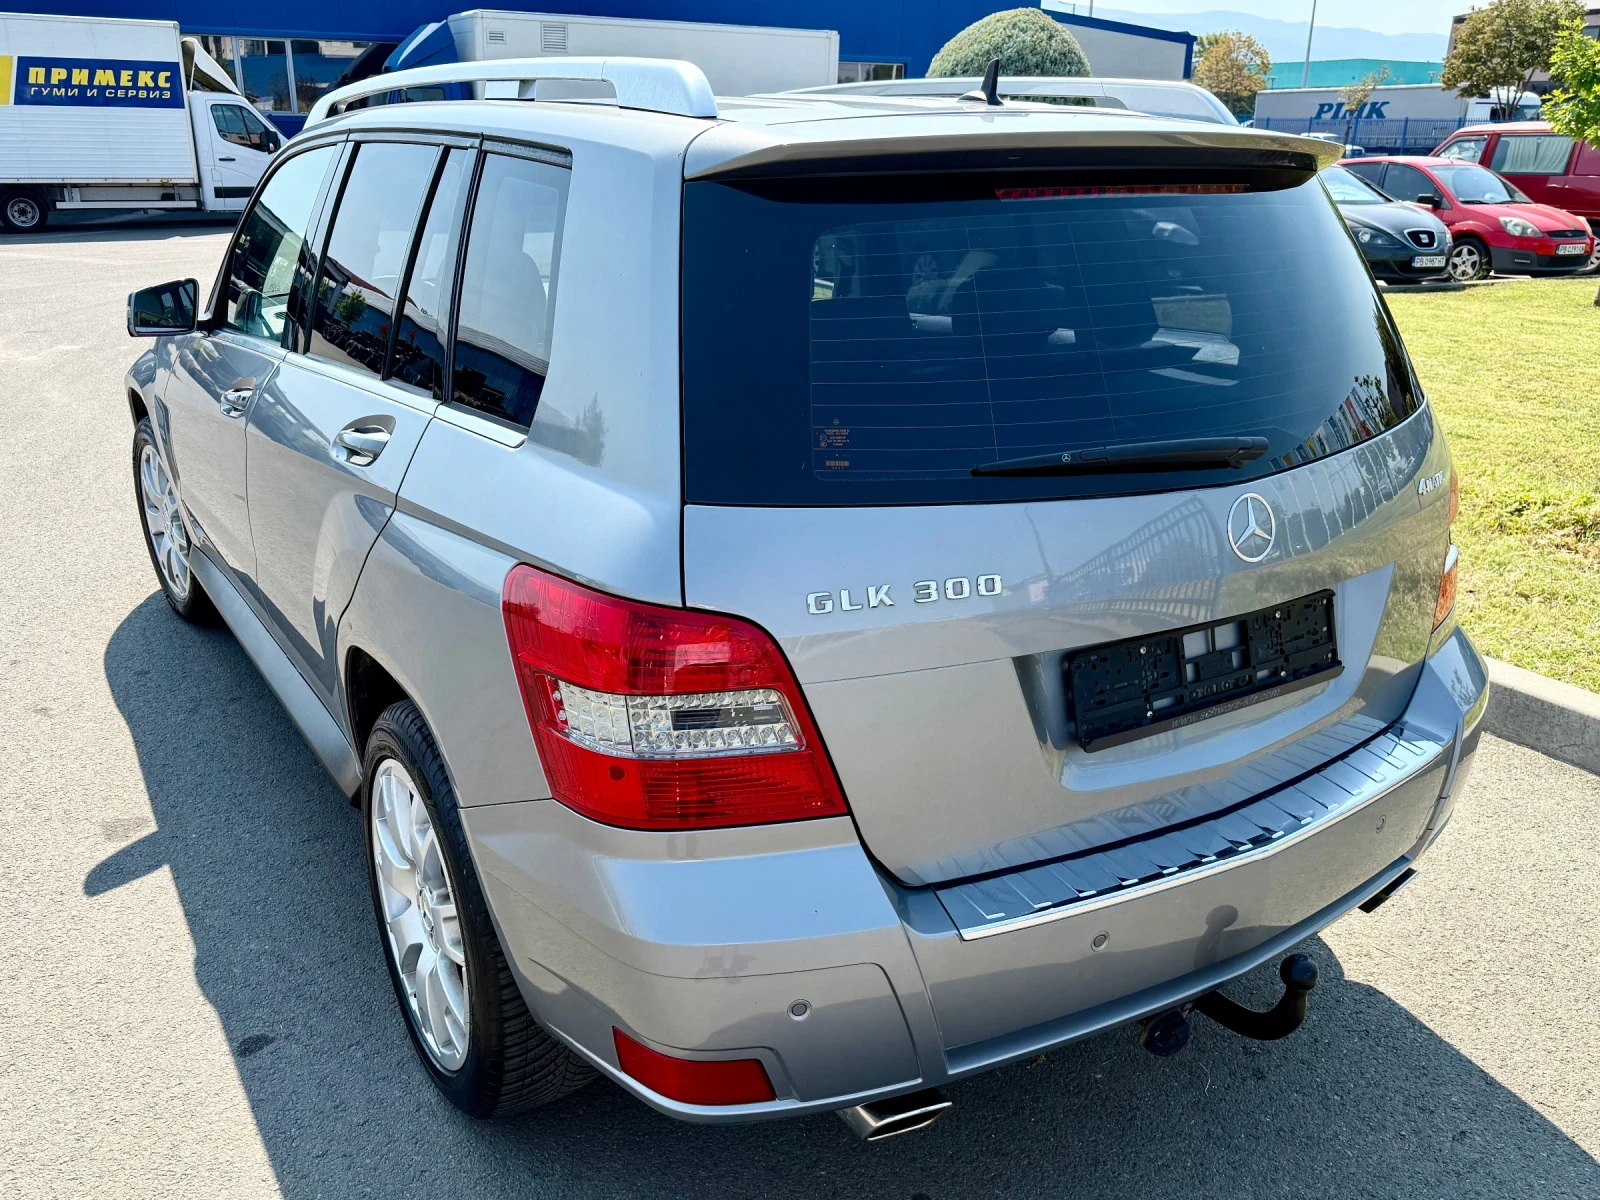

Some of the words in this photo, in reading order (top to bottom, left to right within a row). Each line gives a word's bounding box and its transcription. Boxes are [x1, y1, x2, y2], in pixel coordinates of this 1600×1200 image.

[28, 67, 171, 87] ПРИМЕКС
[31, 87, 79, 97] ГУМИ
[87, 89, 97, 97] И
[106, 89, 171, 99] СЕРВИЗ
[806, 583, 896, 615] GLK
[912, 573, 1003, 603] 300
[1171, 688, 1281, 728] www.schwarz-kfz.com
